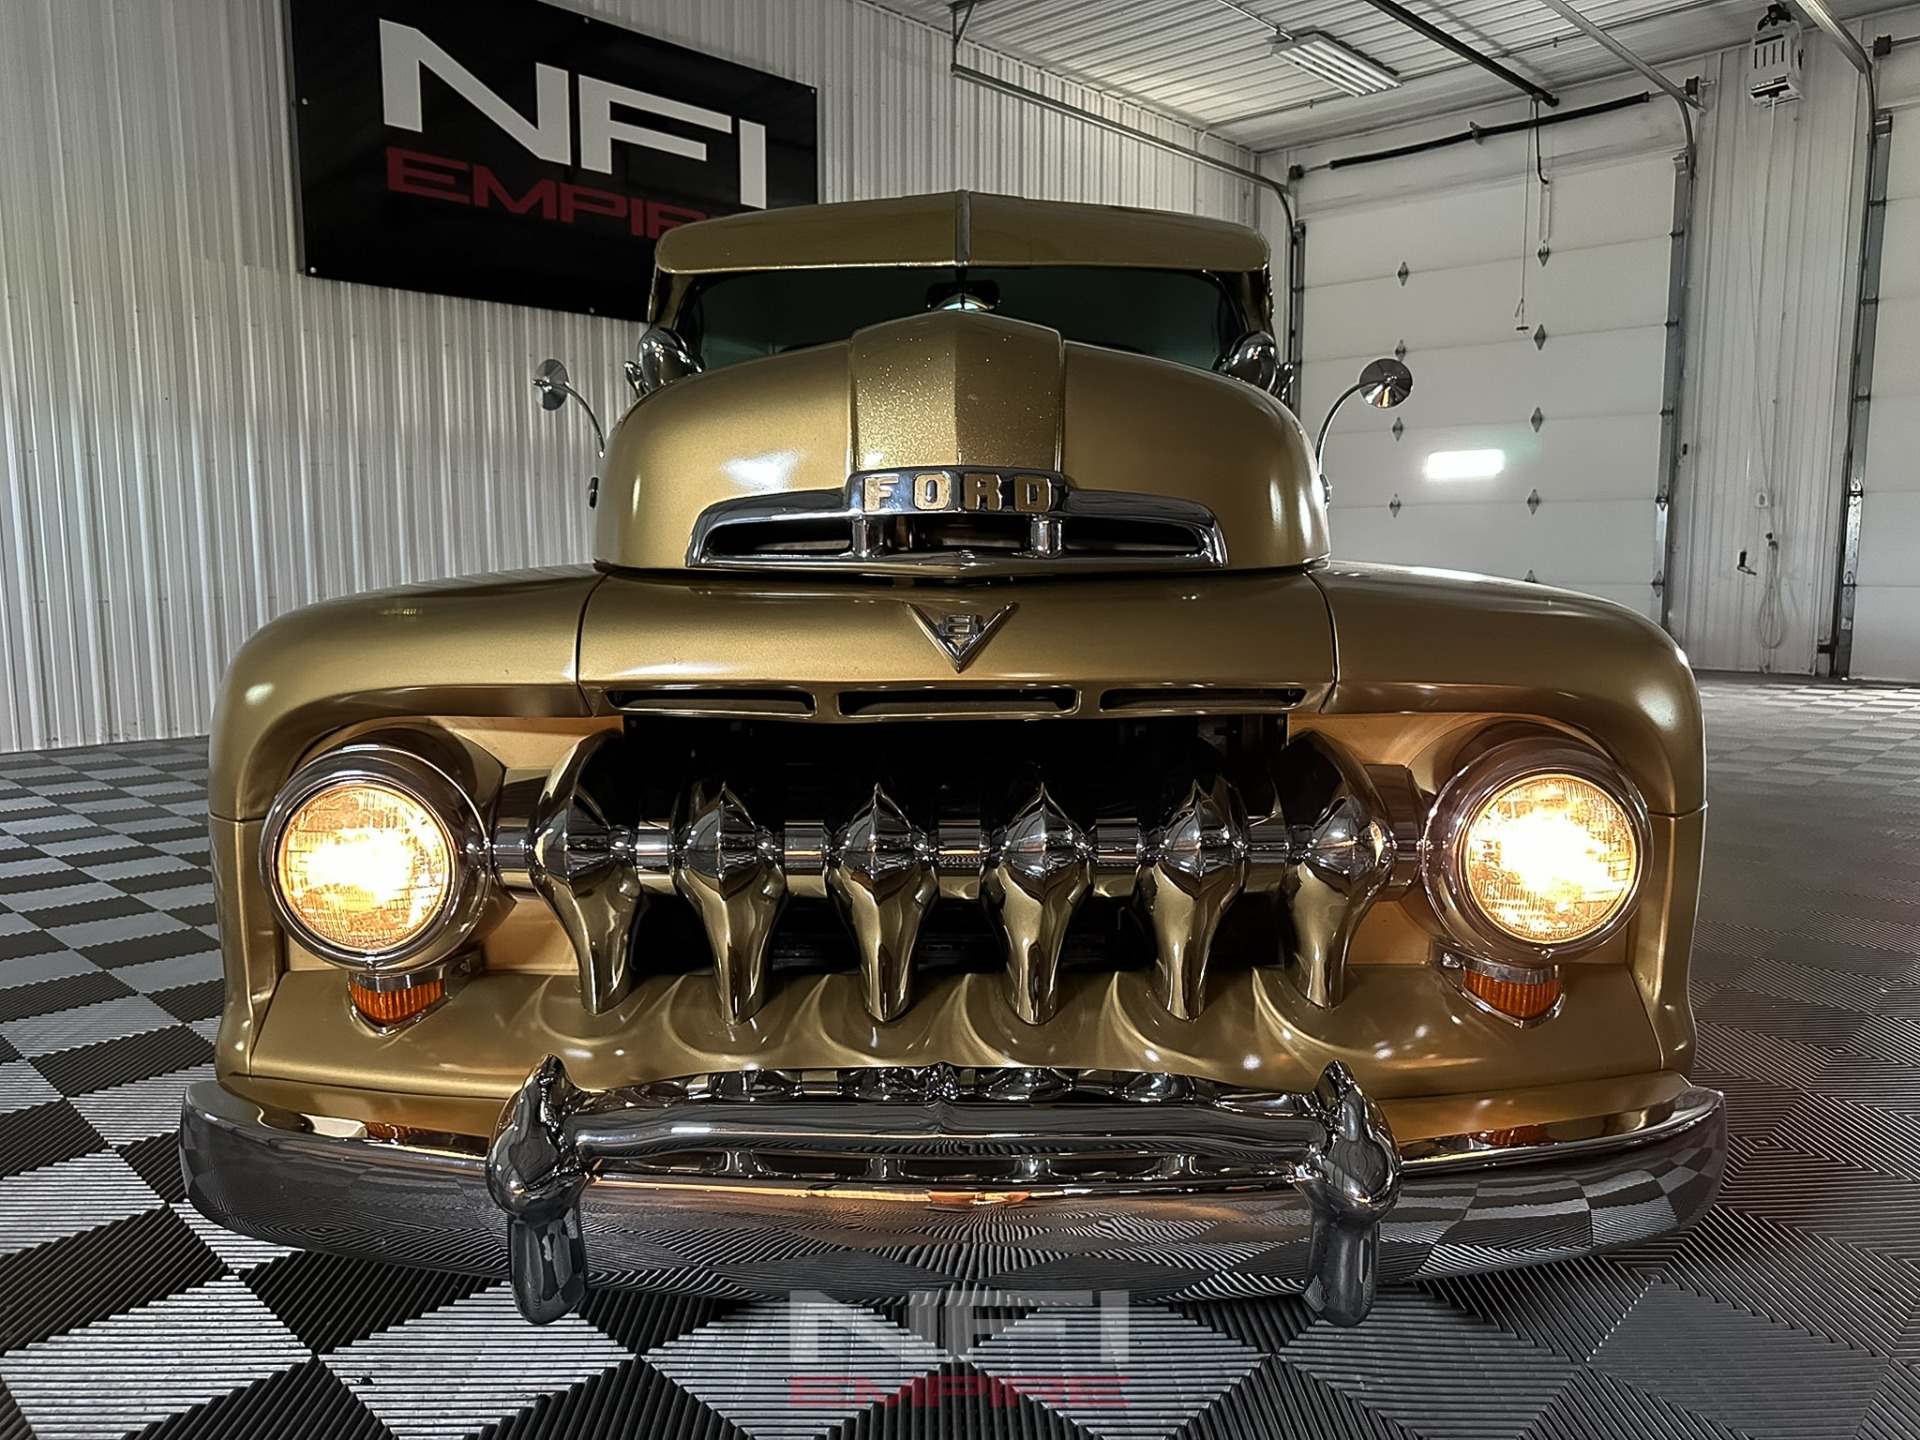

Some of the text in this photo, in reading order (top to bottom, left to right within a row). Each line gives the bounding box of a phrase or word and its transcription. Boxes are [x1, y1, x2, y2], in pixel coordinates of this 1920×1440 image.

[379, 18, 767, 210] NFI
[386, 147, 708, 239] EMPIR
[863, 472, 1051, 512] FORD
